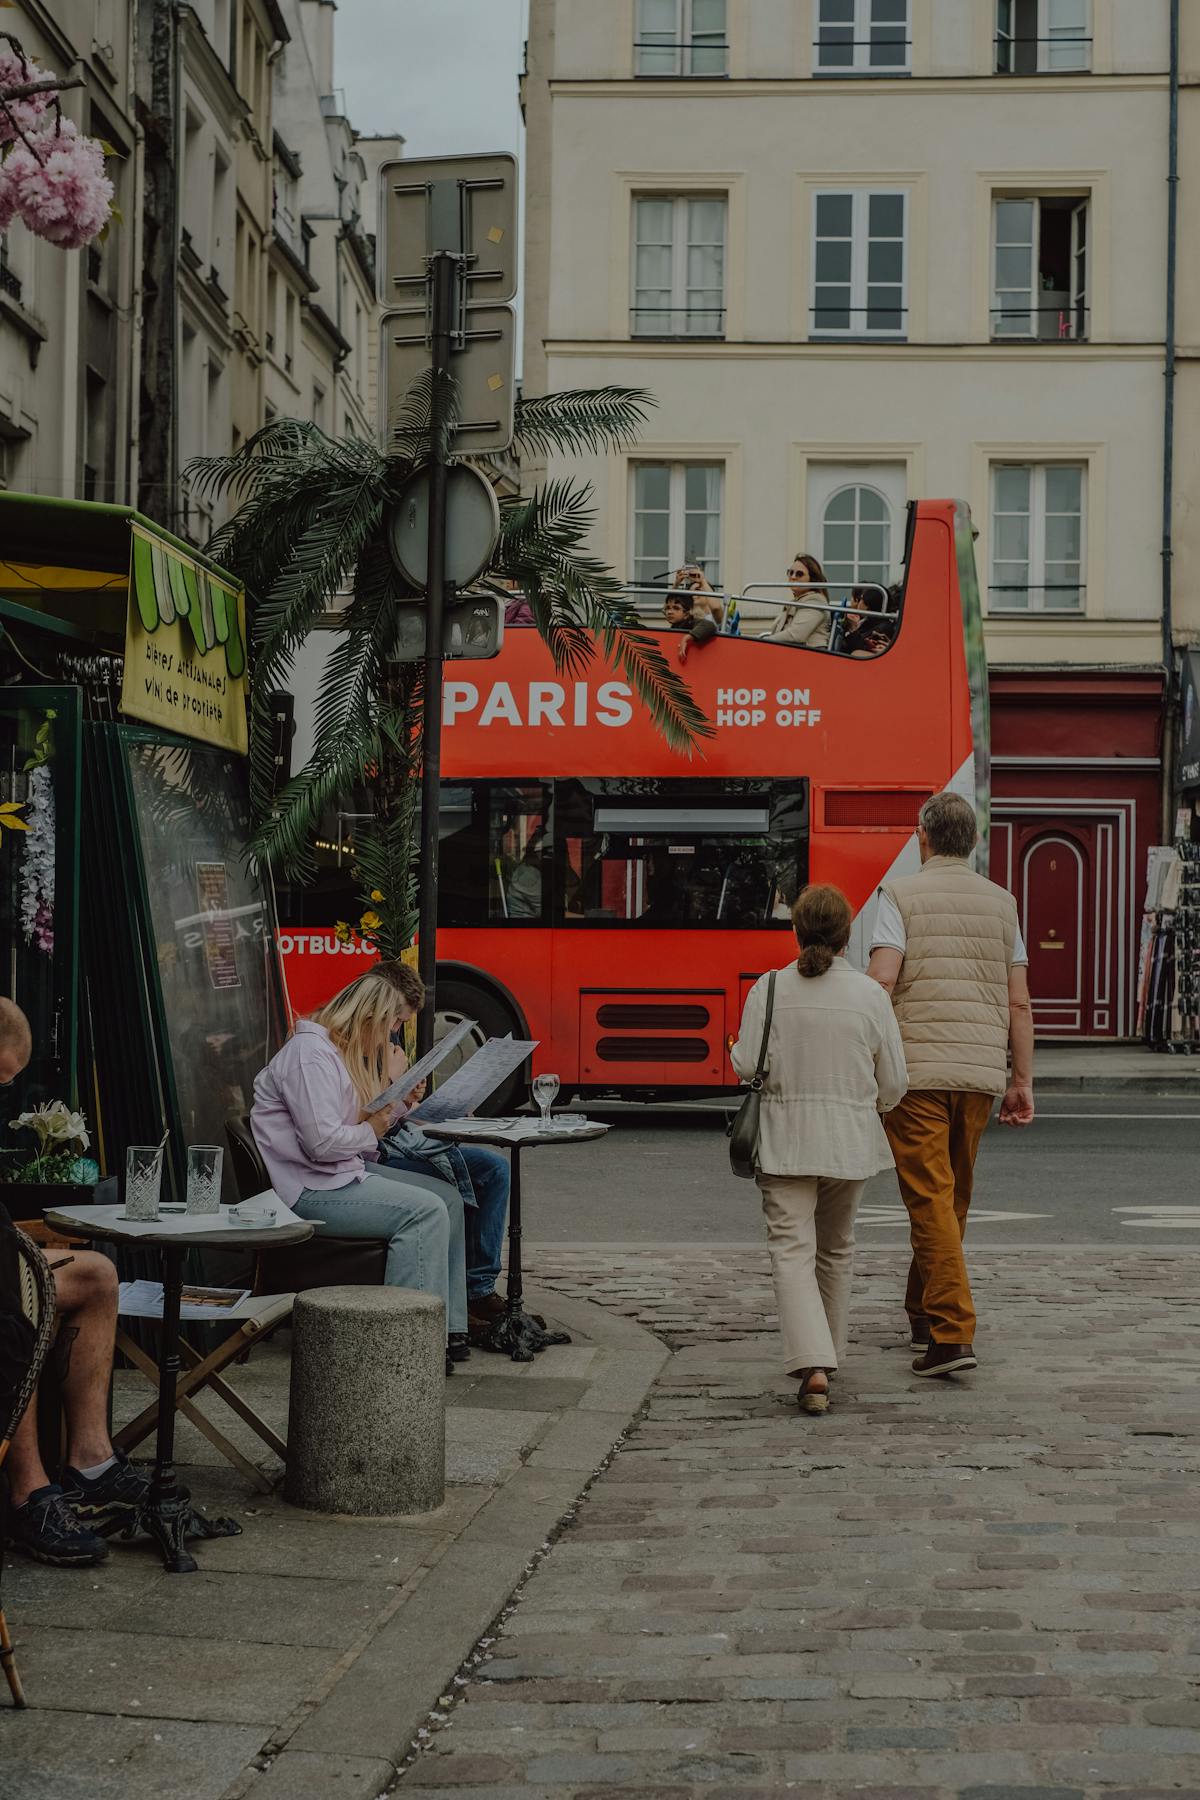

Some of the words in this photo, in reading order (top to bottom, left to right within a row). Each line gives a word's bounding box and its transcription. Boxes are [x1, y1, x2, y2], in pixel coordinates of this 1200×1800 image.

[166, 686, 178, 706] de
[442, 682, 633, 727] PARIS
[716, 688, 765, 705] HOP
[776, 688, 811, 705] ON
[716, 710, 765, 727] HOP
[775, 710, 822, 727] OFF
[279, 934, 382, 955] OTBUS.C
